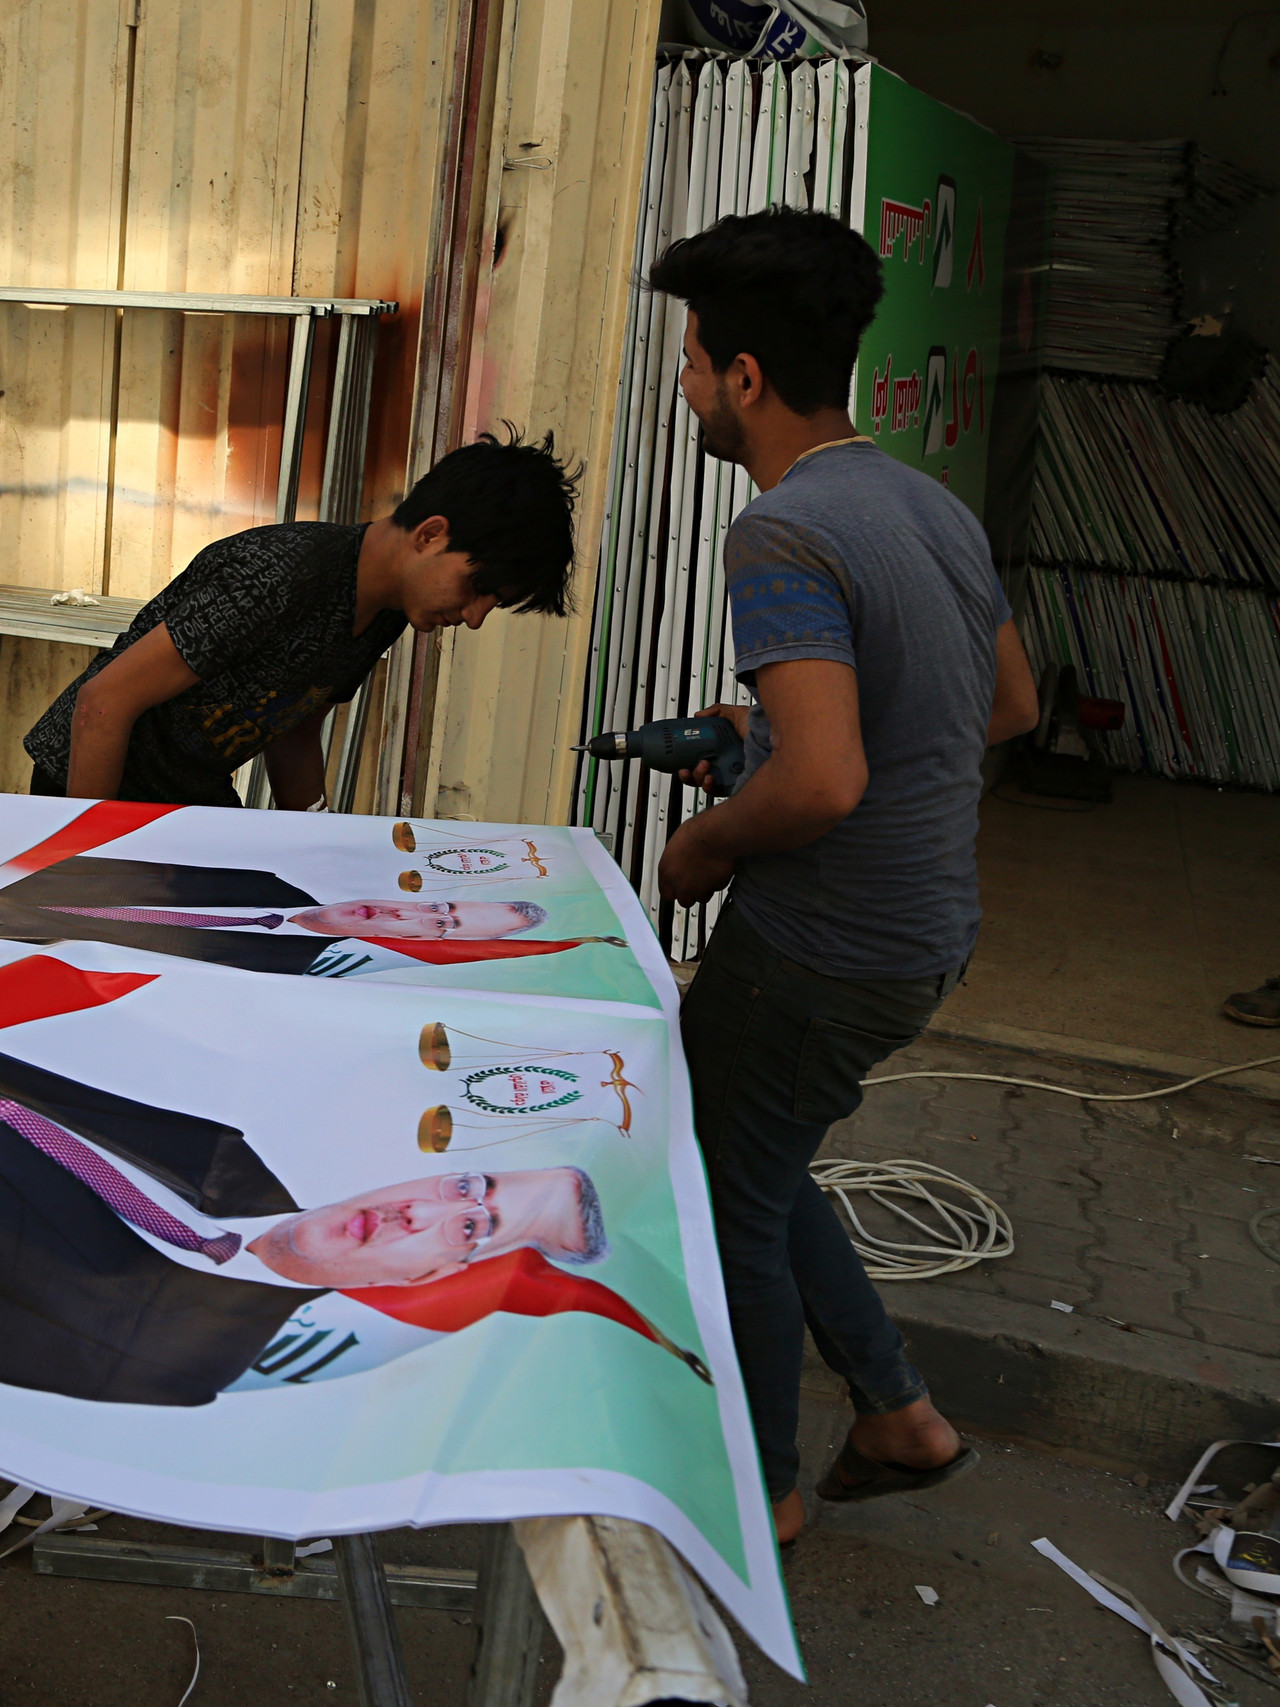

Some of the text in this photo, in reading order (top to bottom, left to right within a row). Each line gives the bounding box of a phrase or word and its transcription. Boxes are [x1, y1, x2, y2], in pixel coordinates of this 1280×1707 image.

[880, 197, 932, 266] التسلسل
[870, 353, 893, 436] رقم
[890, 368, 923, 435] القائمة
